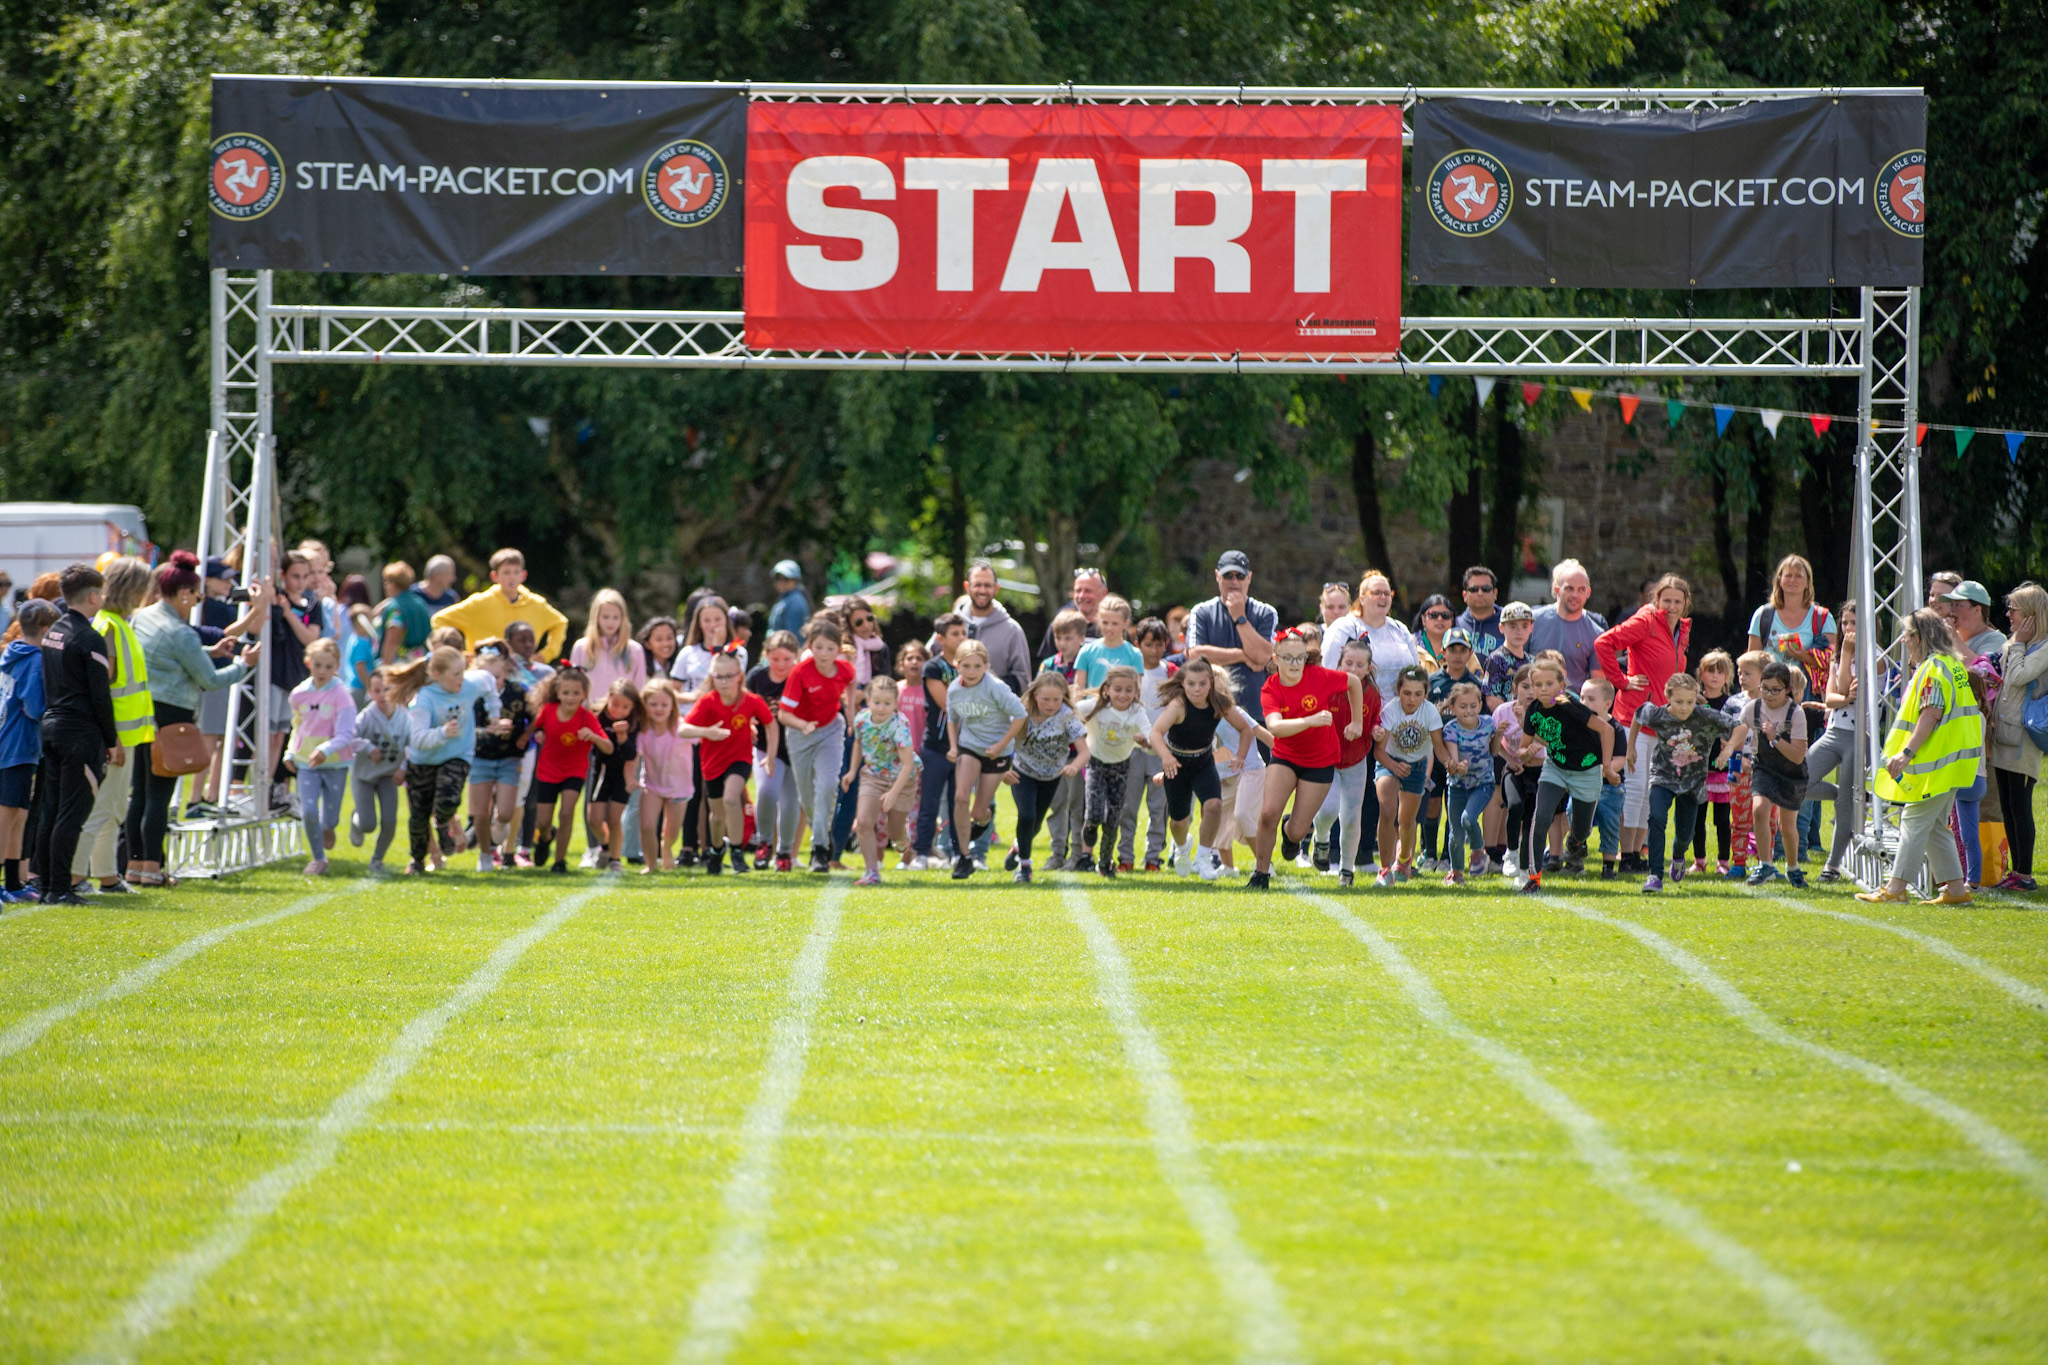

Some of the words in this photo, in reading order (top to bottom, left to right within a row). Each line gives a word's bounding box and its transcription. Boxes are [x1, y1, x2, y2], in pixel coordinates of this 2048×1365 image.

[233, 138, 247, 146] OF
[677, 145, 691, 153] OF
[692, 147, 713, 162] MAN
[296, 161, 634, 196] STEAM-PACKET.COM
[1444, 157, 1462, 171] ISLE
[1477, 156, 1497, 173] MAN
[1892, 158, 1909, 172] ISLE
[1911, 155, 1922, 163] OF
[214, 197, 252, 216] PACKET
[253, 166, 280, 211] COMPANY
[647, 172, 661, 205] STEAM
[657, 204, 695, 222] PACKET
[697, 172, 724, 218] COMPANY
[1432, 180, 1444, 214] STEAM
[1442, 214, 1479, 232] PACKET
[1482, 182, 1508, 228] COMPANY
[1525, 177, 1865, 208] STEAM-PACKET.COM
[1879, 182, 1892, 216] STEAM
[785, 155, 1368, 293] START
[1323, 319, 1376, 328] Management
